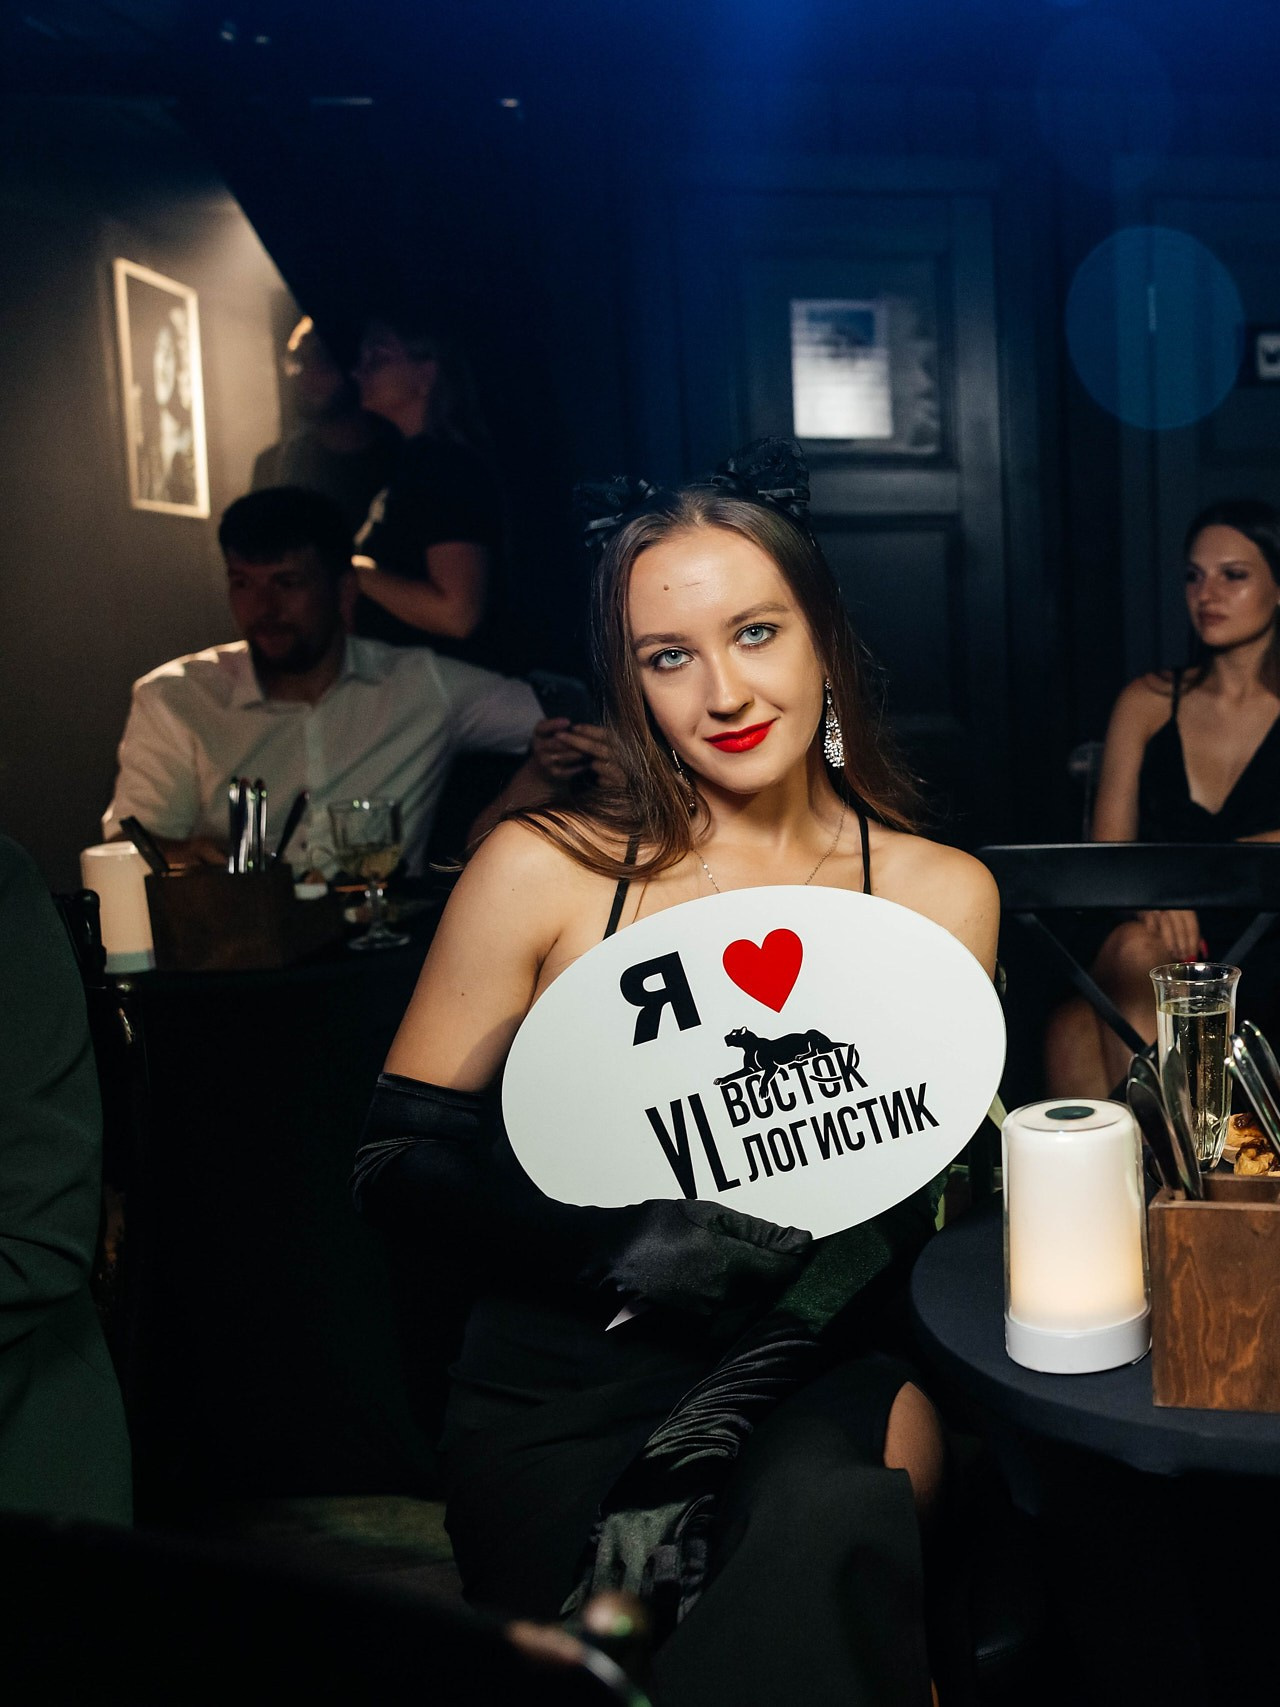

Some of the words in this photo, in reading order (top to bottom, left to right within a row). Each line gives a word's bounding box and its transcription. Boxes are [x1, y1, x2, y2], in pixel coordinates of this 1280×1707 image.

[619, 951, 702, 1046] Я
[720, 1044, 869, 1128] ВОСТОК
[742, 1082, 940, 1183] ЛОГИСТИК
[645, 1093, 741, 1199] VL
